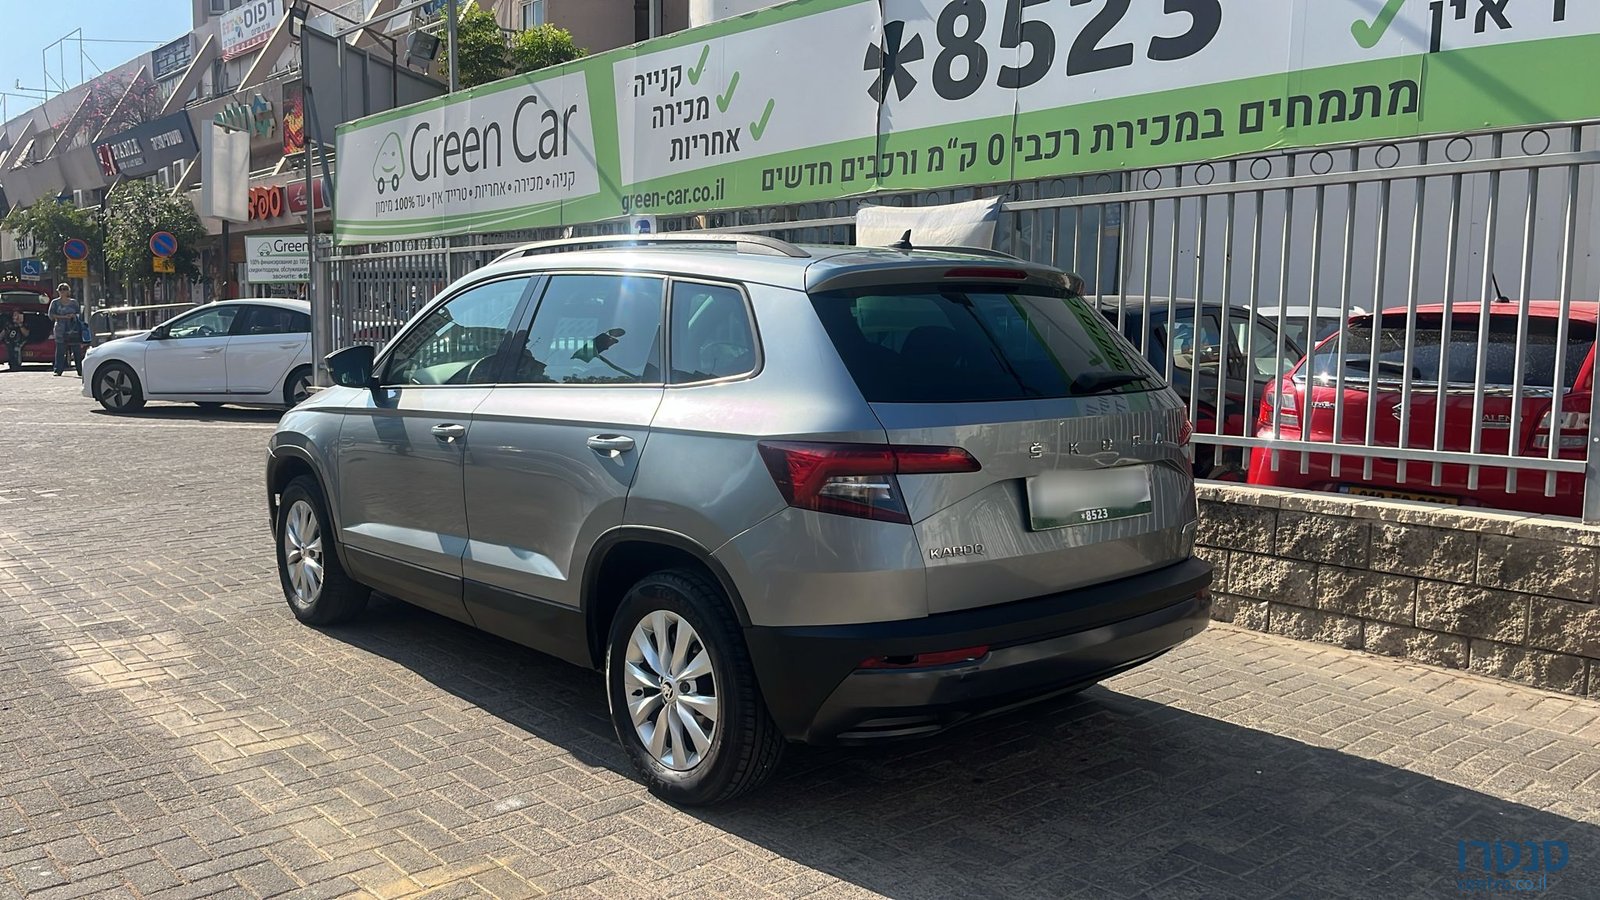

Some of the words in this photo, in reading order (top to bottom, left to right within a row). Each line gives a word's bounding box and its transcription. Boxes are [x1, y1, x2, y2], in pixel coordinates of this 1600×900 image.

[243, 0, 275, 29] דפוס
[633, 64, 682, 97] קנייה
[652, 96, 710, 129] מכירה
[1238, 78, 1419, 134] מתמחים
[410, 121, 502, 182] Green
[512, 95, 578, 164] Car
[669, 127, 741, 162] אחריות
[1013, 128, 1080, 162] רכבי
[1090, 108, 1224, 153] במכירת
[987, 133, 1005, 166] 0
[552, 171, 575, 191] קניה
[761, 161, 833, 192] חדשים
[840, 150, 917, 182] ורכבים
[432, 190, 443, 209] אין
[445, 187, 468, 203] טרייד
[474, 181, 506, 199] אחריות
[514, 175, 543, 194] מכירה
[621, 177, 725, 215] green-car.co.il
[375, 199, 393, 217] מימון
[394, 196, 416, 211] 100%
[416, 194, 426, 208] עד
[274, 239, 309, 252] Green
[929, 543, 985, 560] KAROQ
